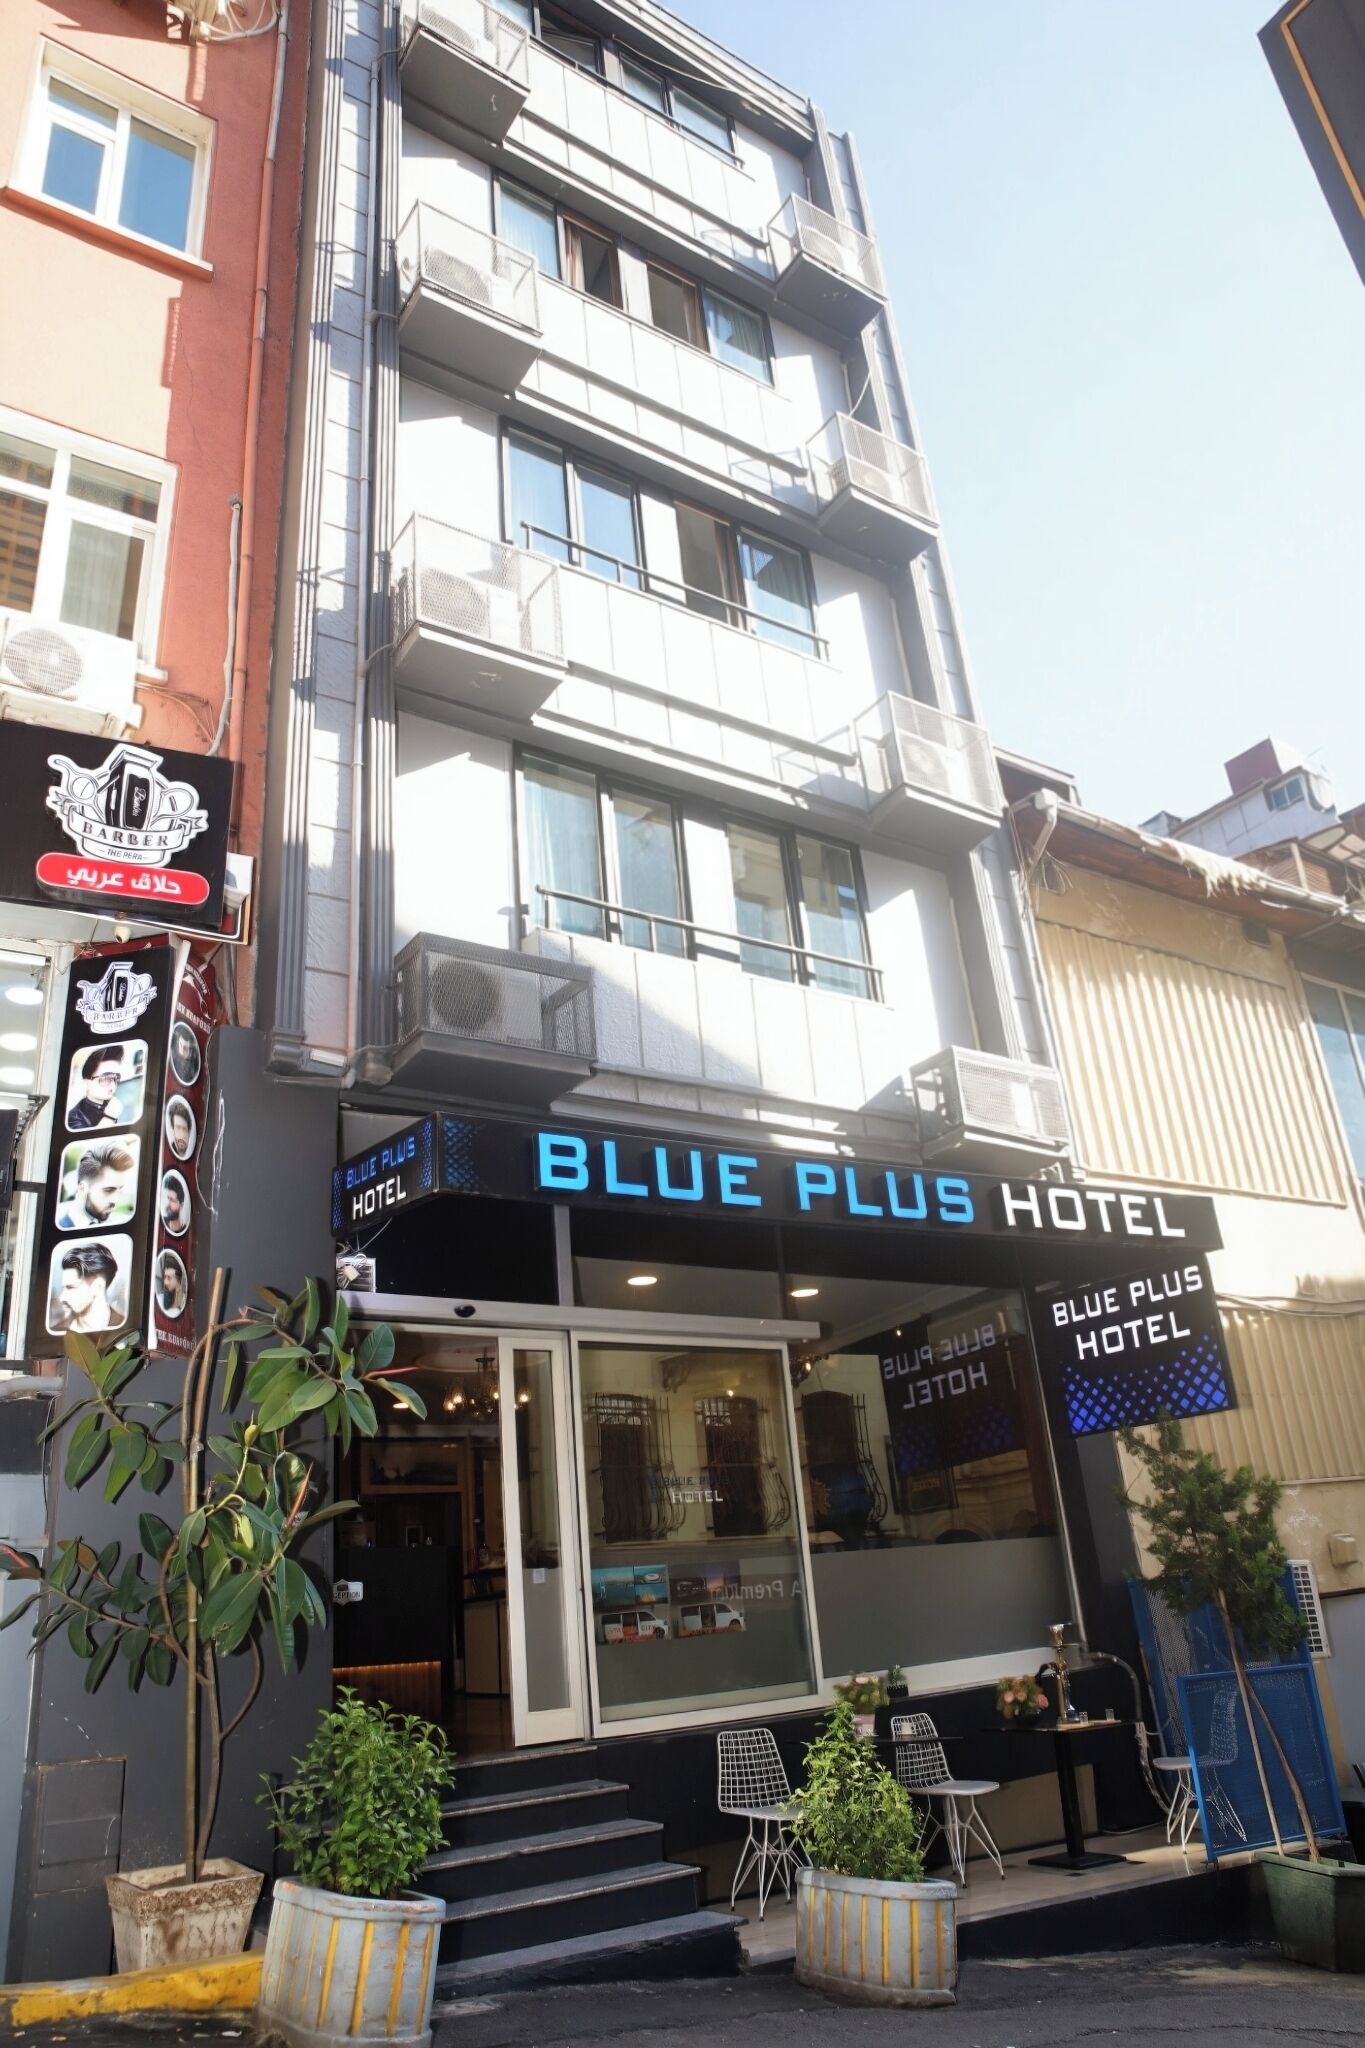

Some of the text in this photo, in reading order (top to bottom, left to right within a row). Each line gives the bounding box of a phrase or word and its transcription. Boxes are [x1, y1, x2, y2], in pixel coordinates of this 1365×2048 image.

[83, 822, 169, 847] BARBER
[107, 848, 143, 861] THE PERA
[66, 867, 182, 895] حلاق عربي
[93, 1007, 139, 1021] BARBER
[346, 1136, 415, 1190] BLUE PLUS
[353, 1174, 407, 1220] HOTEL
[538, 1132, 1187, 1239] BLUE PLUS HOTEL
[1052, 1264, 1203, 1327] BLUE PLUS
[1075, 1311, 1191, 1360] HOTEL
[672, 1489, 724, 1504] HOTEL
